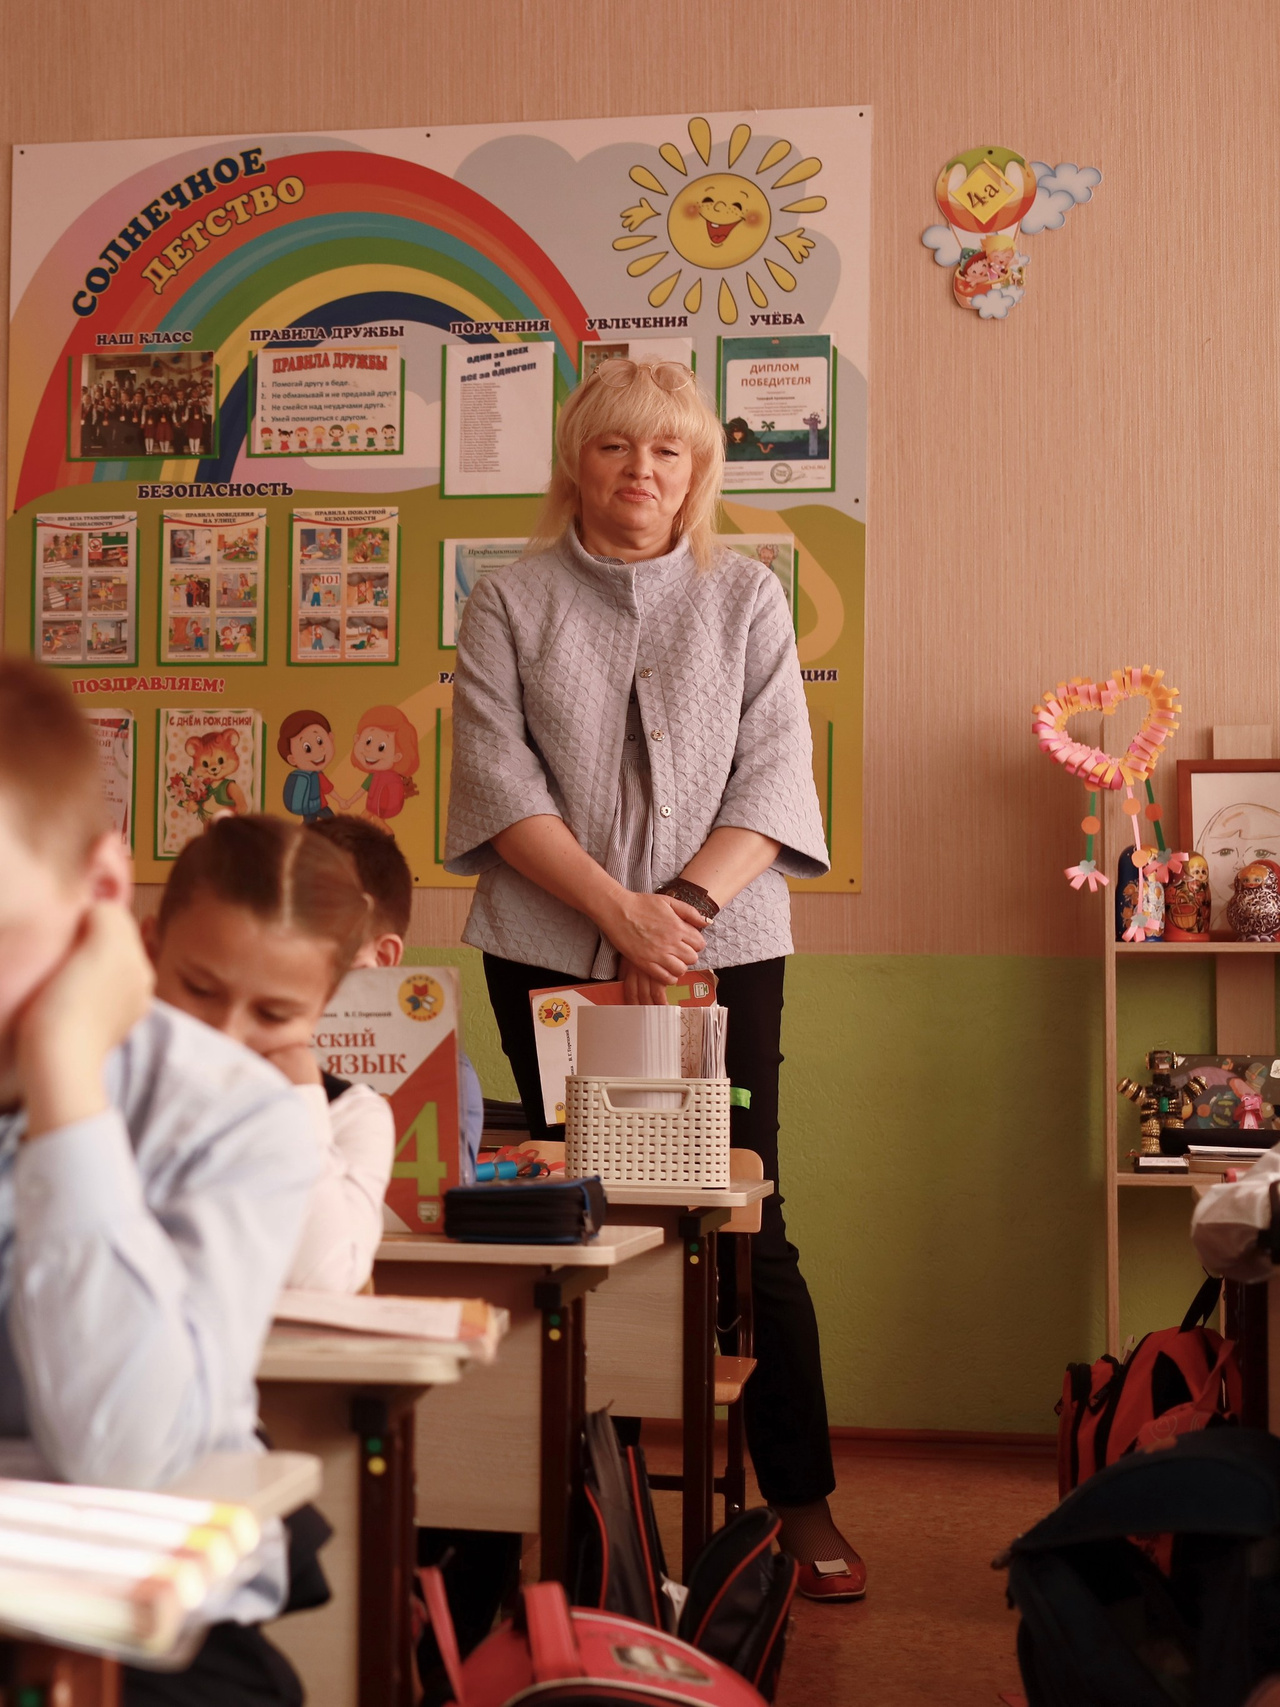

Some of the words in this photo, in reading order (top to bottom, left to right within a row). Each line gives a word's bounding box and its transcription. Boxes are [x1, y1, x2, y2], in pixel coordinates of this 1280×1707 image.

[71, 147, 267, 317] СОЛНЕЧНОЕ
[140, 175, 305, 295] ДЕТСТВО
[450, 319, 550, 335] ПОРУЧЕНИЯ
[586, 315, 689, 331] УВЛЕЧЕНИЯ
[749, 311, 805, 327] УЧЁБА
[96, 333, 134, 346] НАШ
[138, 331, 193, 345] КЛАСС
[249, 327, 326, 342] ПРАВИЛА
[330, 325, 405, 341] ДРУЖБЫ
[272, 352, 330, 374] ПРАВИЛА
[333, 352, 388, 371] ДРУЖБЫ
[466, 353, 492, 364] ОДИН
[493, 351, 505, 359] за
[506, 346, 529, 357] ВСЕХ
[750, 363, 799, 374] ДИПЛОМ
[304, 381, 323, 389] другу
[460, 373, 477, 383] ВСЕ
[479, 372, 490, 380] за
[741, 376, 811, 387] ПОБЕДИТЕЛЯ
[324, 403, 363, 411] неудачами
[137, 482, 293, 499] БЕЗОПАСНОСТЬ
[347, 508, 387, 516] ПОЖАРНОЙ
[321, 575, 340, 584] 101
[71, 676, 225, 694] ПОЗДРАВЛЯЕМ!
[169, 716, 175, 726] С
[176, 714, 201, 727] ДНЁМ
[203, 716, 252, 727] РОЖДЕНИЯ!
[391, 1101, 447, 1196] 4
